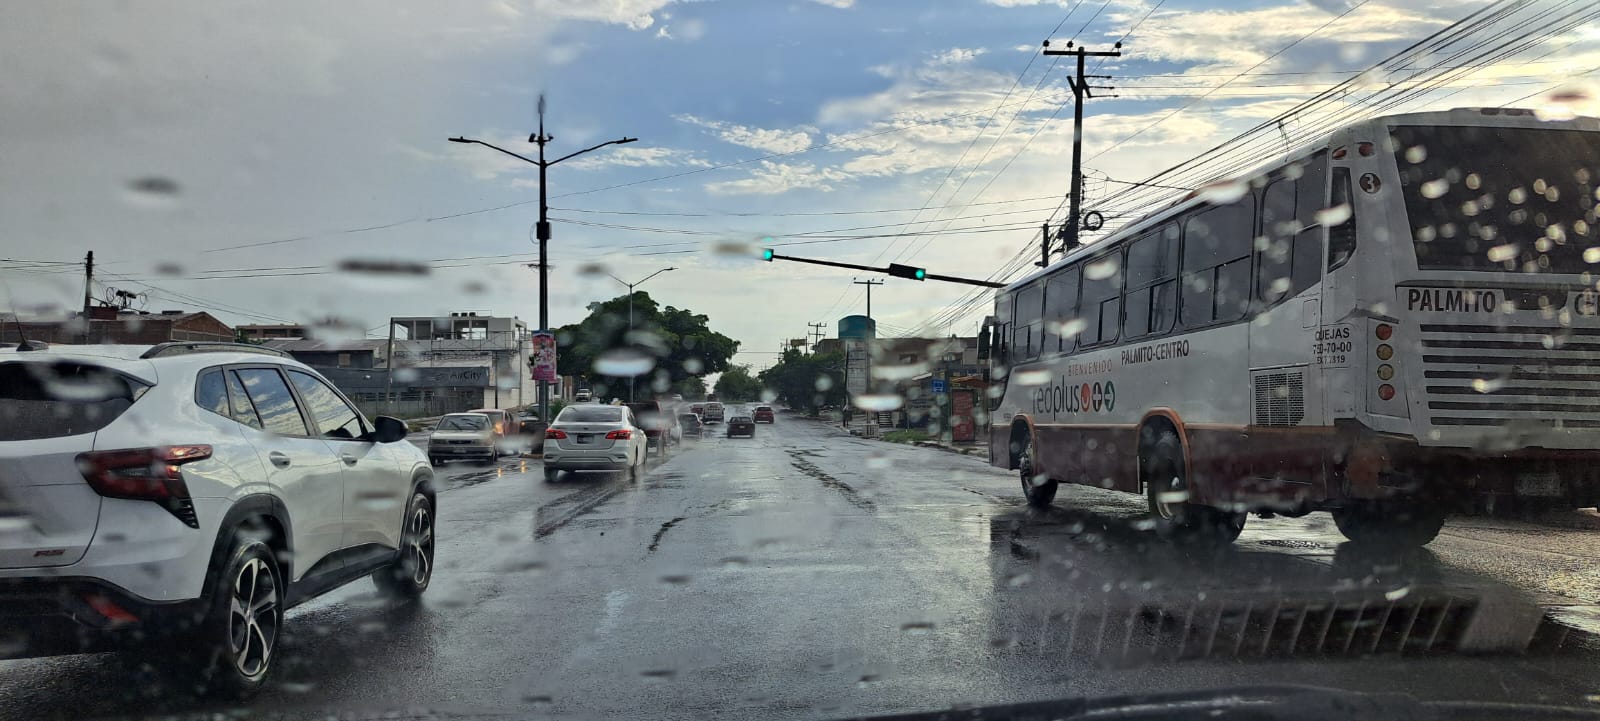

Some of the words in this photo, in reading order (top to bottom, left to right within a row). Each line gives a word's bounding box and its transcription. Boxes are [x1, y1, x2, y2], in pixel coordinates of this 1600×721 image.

[1366, 174, 1375, 193] 3
[1408, 289, 1496, 313] PALMITO
[1574, 294, 1600, 316] CE
[1315, 328, 1350, 341] QUEJAS
[1121, 340, 1190, 365] PALMITO-CENTRO
